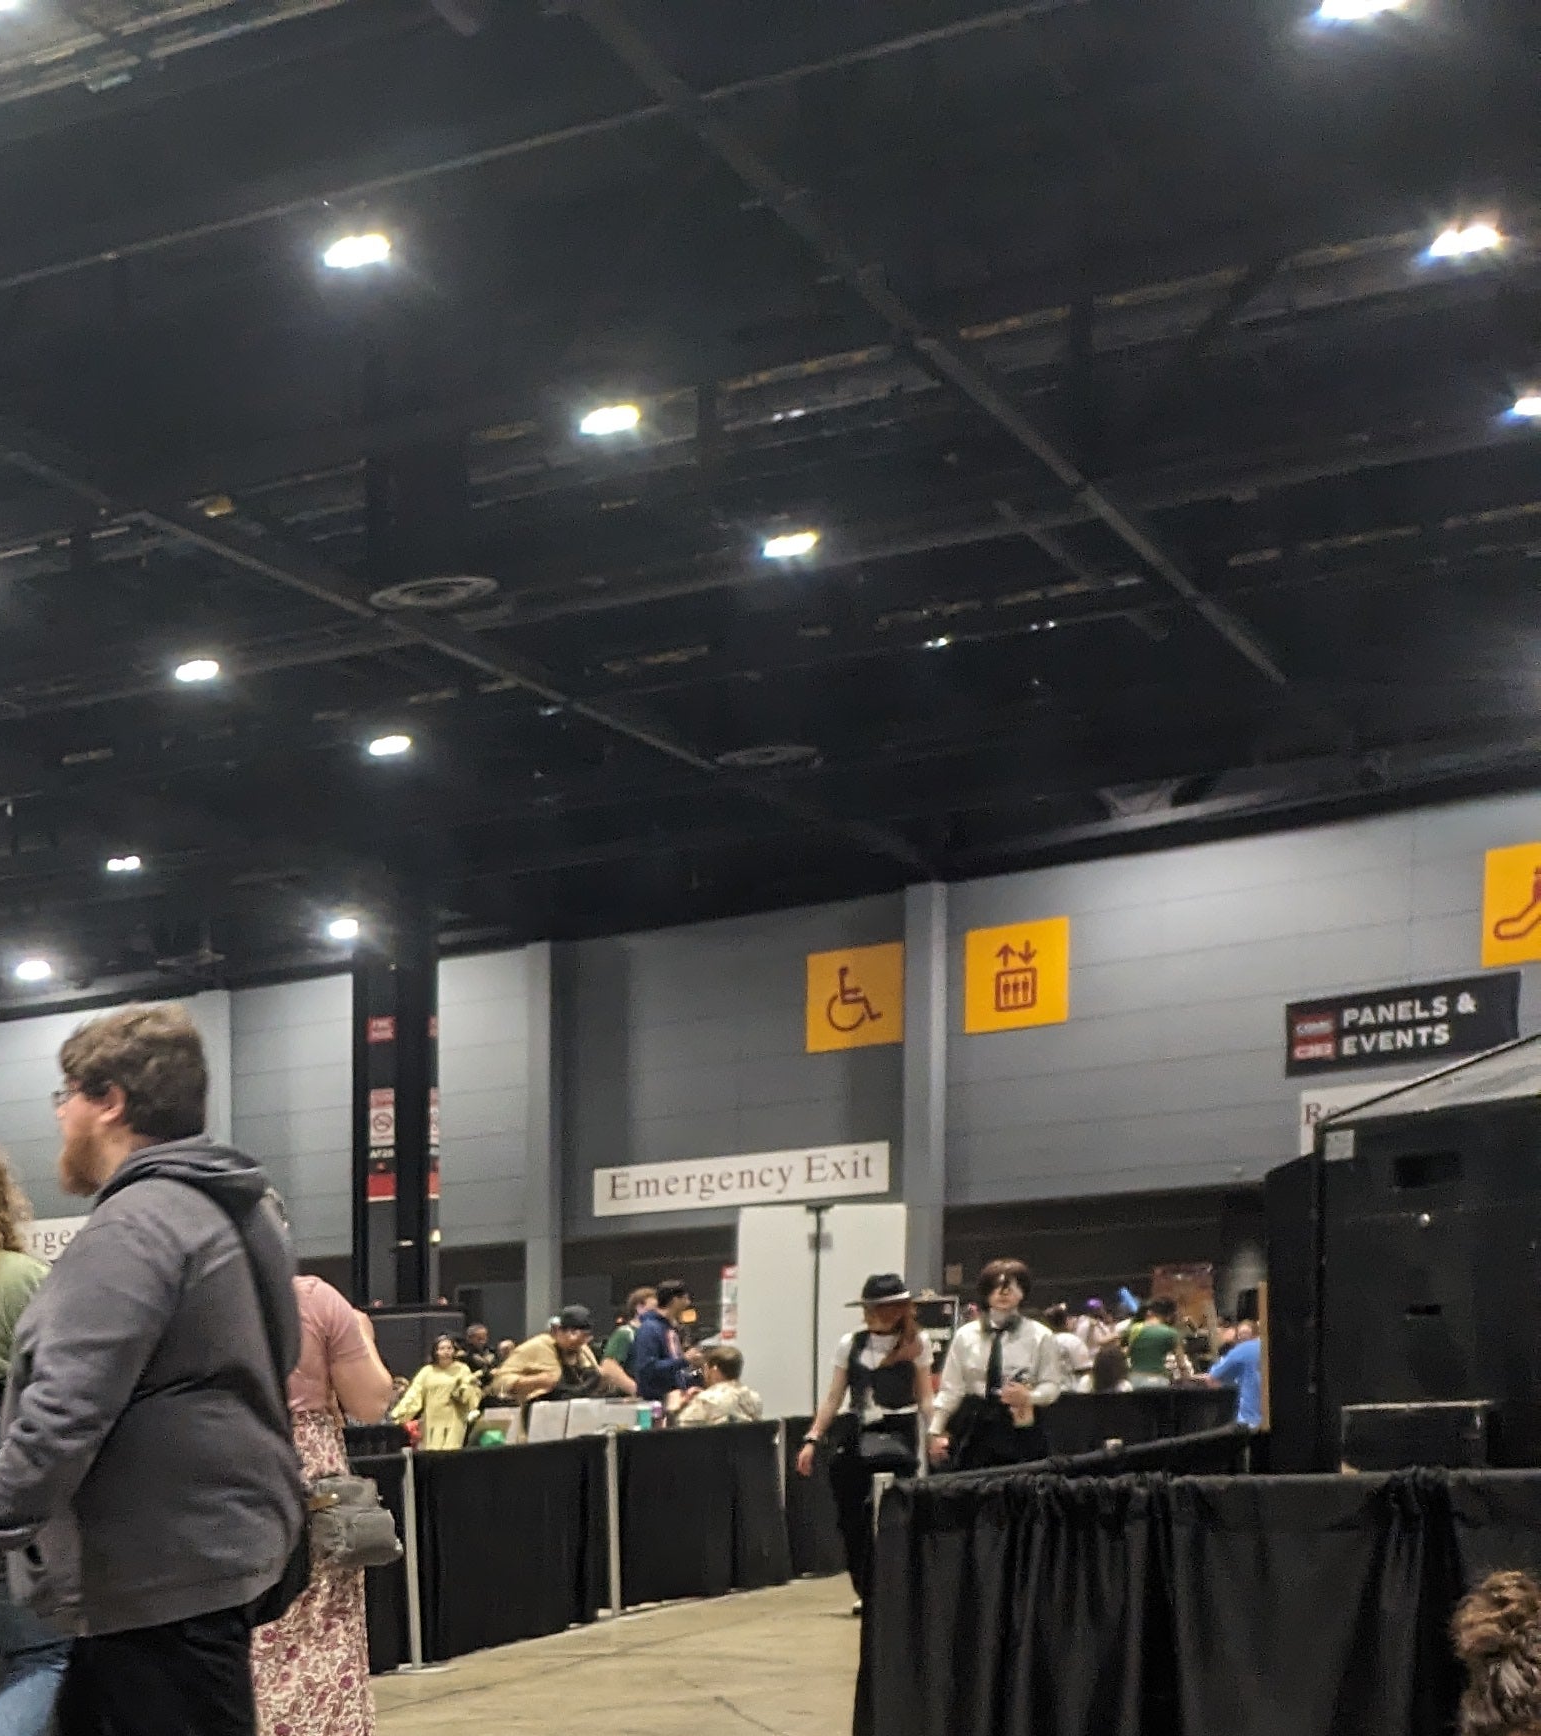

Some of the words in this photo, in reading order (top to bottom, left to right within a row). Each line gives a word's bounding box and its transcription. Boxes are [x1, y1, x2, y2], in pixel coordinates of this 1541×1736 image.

[1342, 995, 1449, 1029] PANELS
[1456, 991, 1478, 1015] &
[1342, 1023, 1451, 1056] EVENTS
[609, 1164, 794, 1202] Emergency
[804, 1150, 874, 1184] Exit
